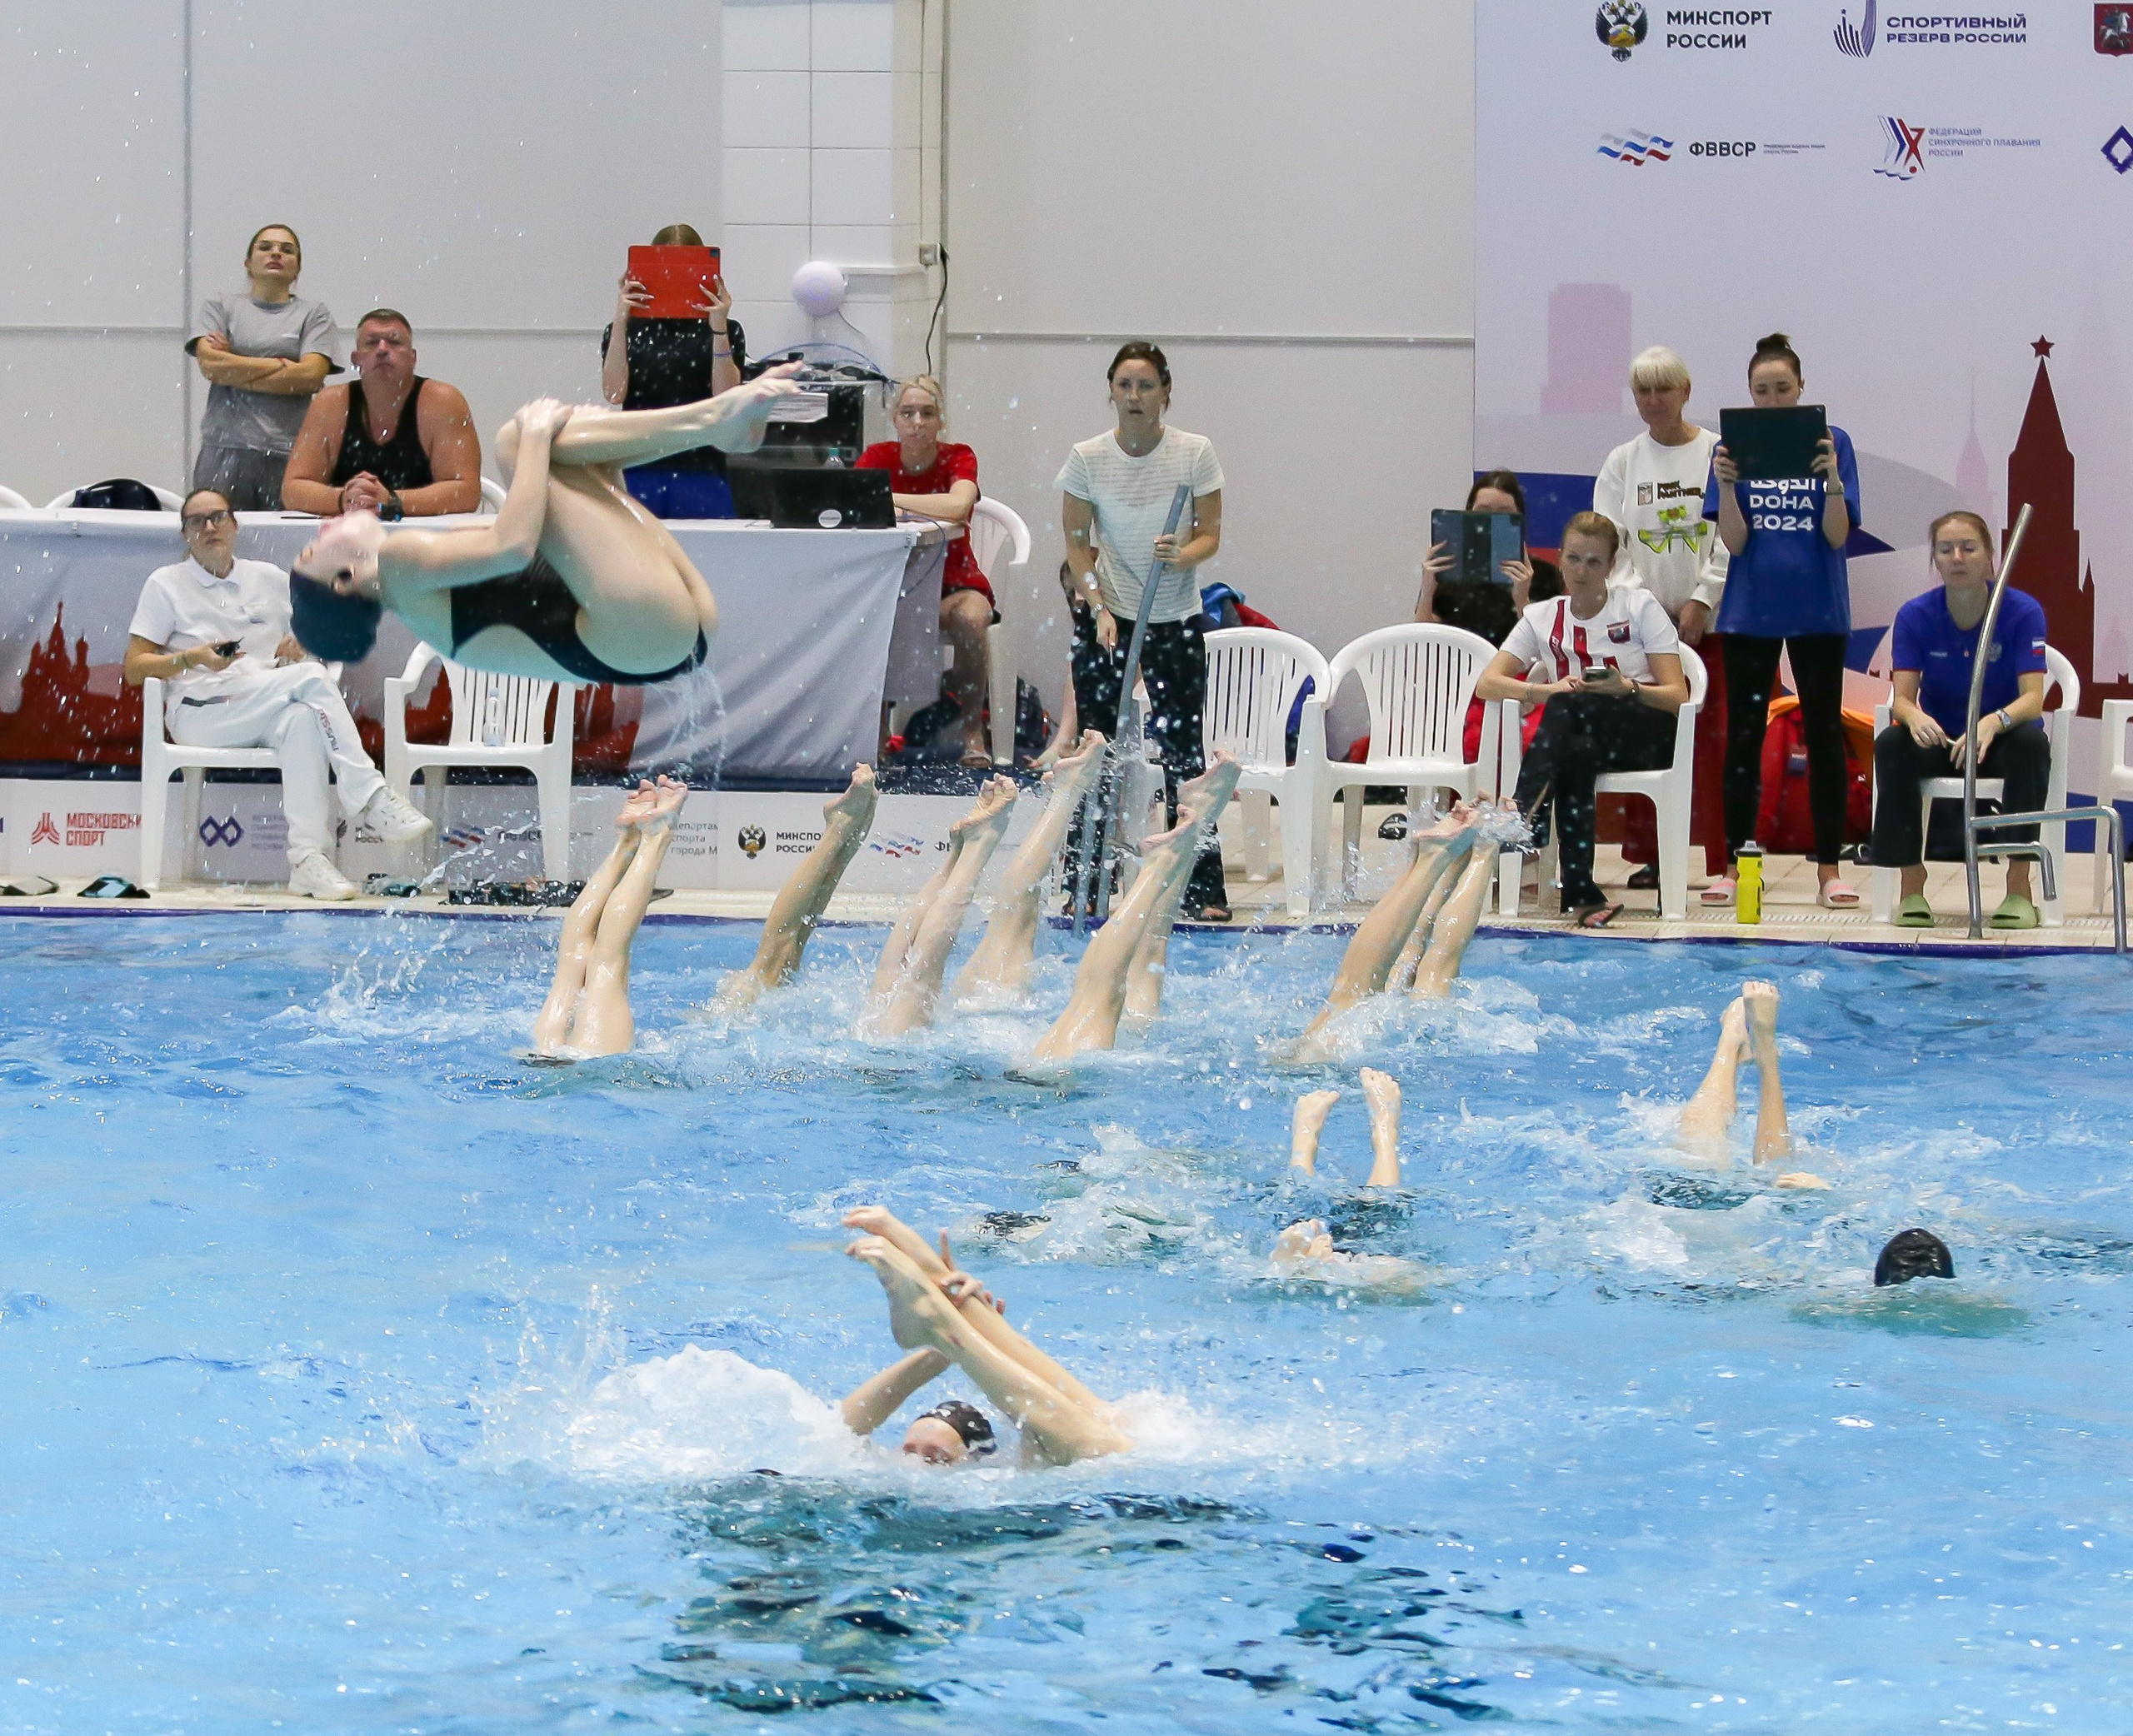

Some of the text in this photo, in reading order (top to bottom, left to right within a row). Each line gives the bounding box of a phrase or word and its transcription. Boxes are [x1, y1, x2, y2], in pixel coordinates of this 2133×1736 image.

[1666, 11, 1772, 25] МИНСПОРТ
[1886, 13, 2026, 28] СПОРТИВНЫЙ
[1666, 34, 1746, 48] РОССИИ
[1886, 33, 2026, 42] РЕЗЕРВ РОССИИ
[1928, 127, 1982, 137] ФЕДЕРАЦИЯ
[1689, 142, 1756, 157] ФВВСР
[1993, 138, 2041, 147] ПЛАВАНИЯ
[1750, 495, 1814, 510] DOHA
[1752, 514, 1814, 531] 2024
[67, 813, 142, 829] МОСКОВСКИ
[67, 831, 106, 846] СПОРТ
[777, 831, 823, 841] МИНСПО
